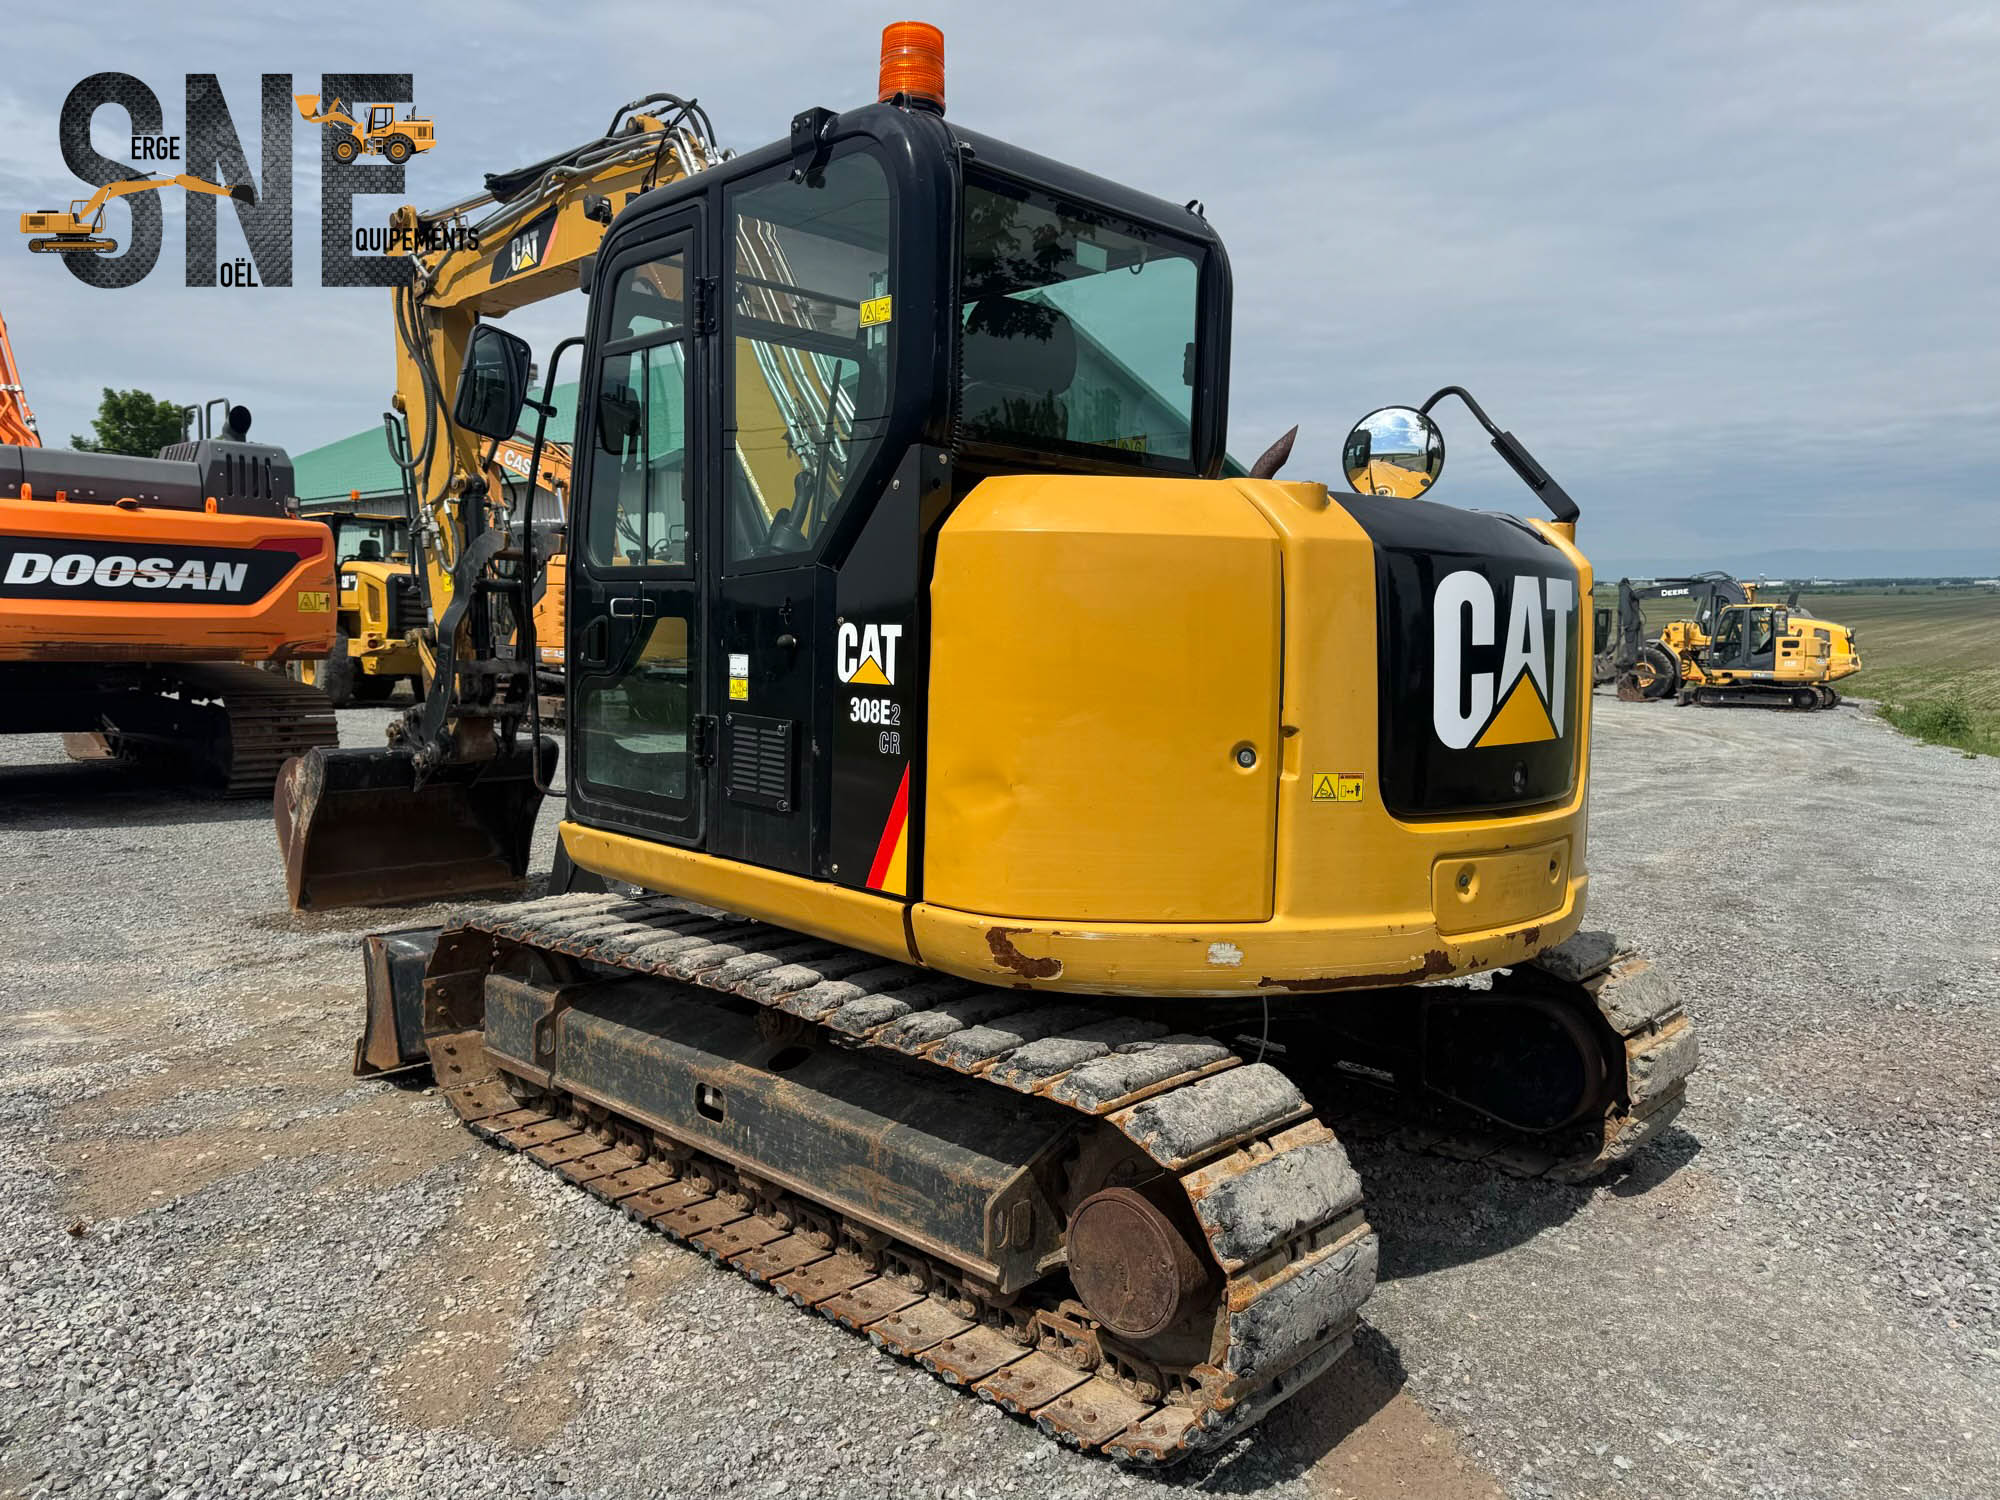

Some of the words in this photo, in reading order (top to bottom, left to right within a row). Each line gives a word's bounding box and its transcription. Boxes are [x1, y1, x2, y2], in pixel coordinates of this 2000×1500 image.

[512, 229, 539, 271] CAT
[3, 553, 248, 592] DOOSAN
[1661, 588, 1689, 597] DEERE
[837, 622, 902, 686] CAT
[1433, 570, 1573, 750] CAT
[850, 697, 901, 726] 308E2
[879, 731, 901, 755] CR
